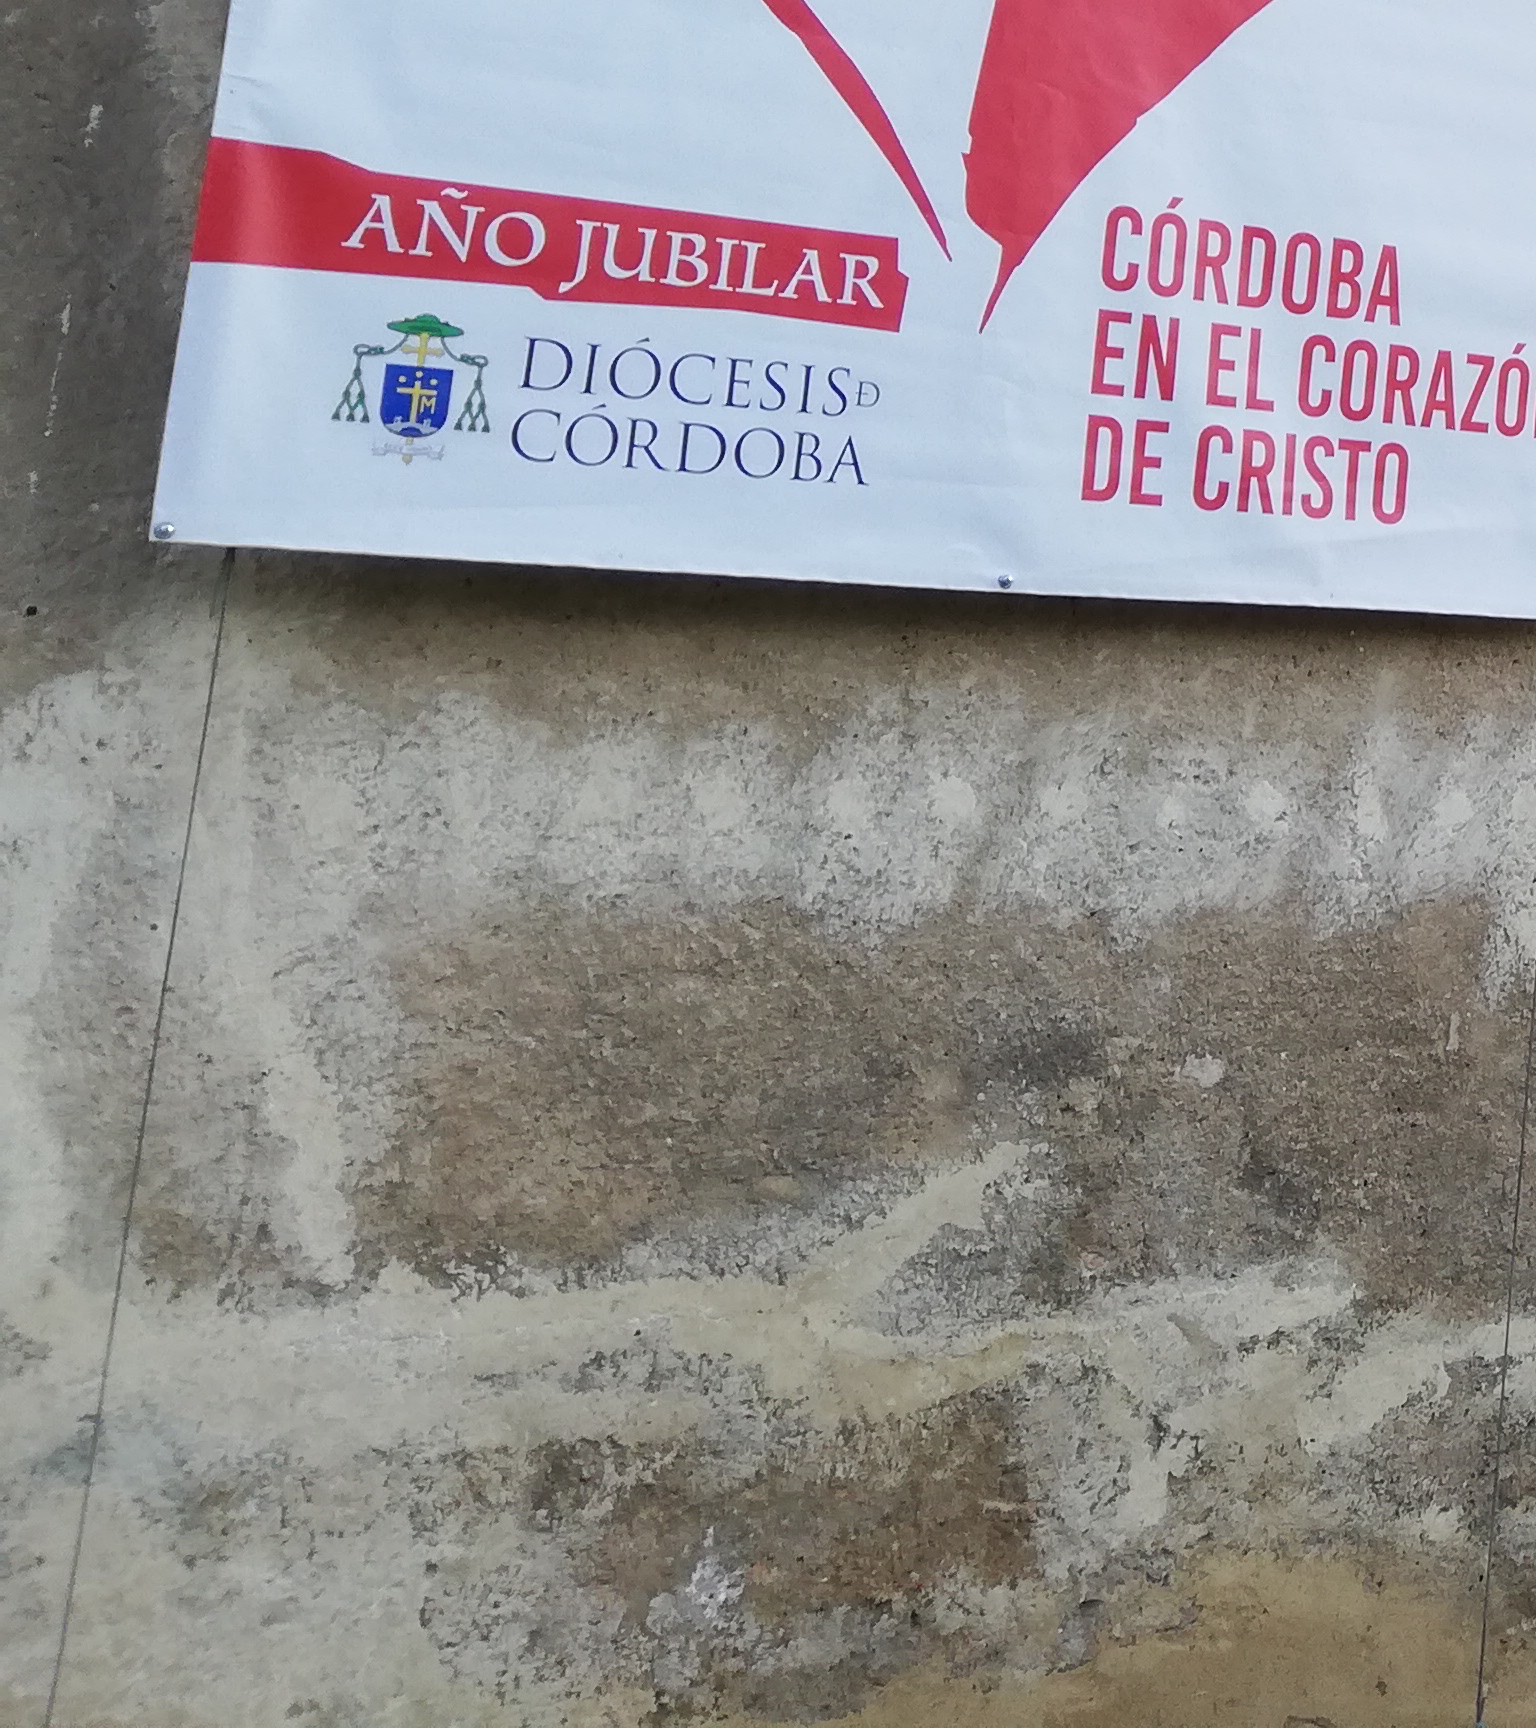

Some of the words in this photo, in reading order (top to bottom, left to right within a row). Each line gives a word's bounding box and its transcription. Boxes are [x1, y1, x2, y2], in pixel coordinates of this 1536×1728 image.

[342, 188, 546, 267] AÑO
[558, 218, 885, 309] JUBILAR
[1101, 197, 1401, 326] CÓRDOBA
[518, 335, 850, 417] DIÓCESIS
[1091, 308, 1180, 402] EN
[1205, 322, 1275, 412] EL
[511, 403, 869, 486] CÓRDOBA
[1081, 414, 1170, 506] DE
[1192, 424, 1410, 525] CRISTO
